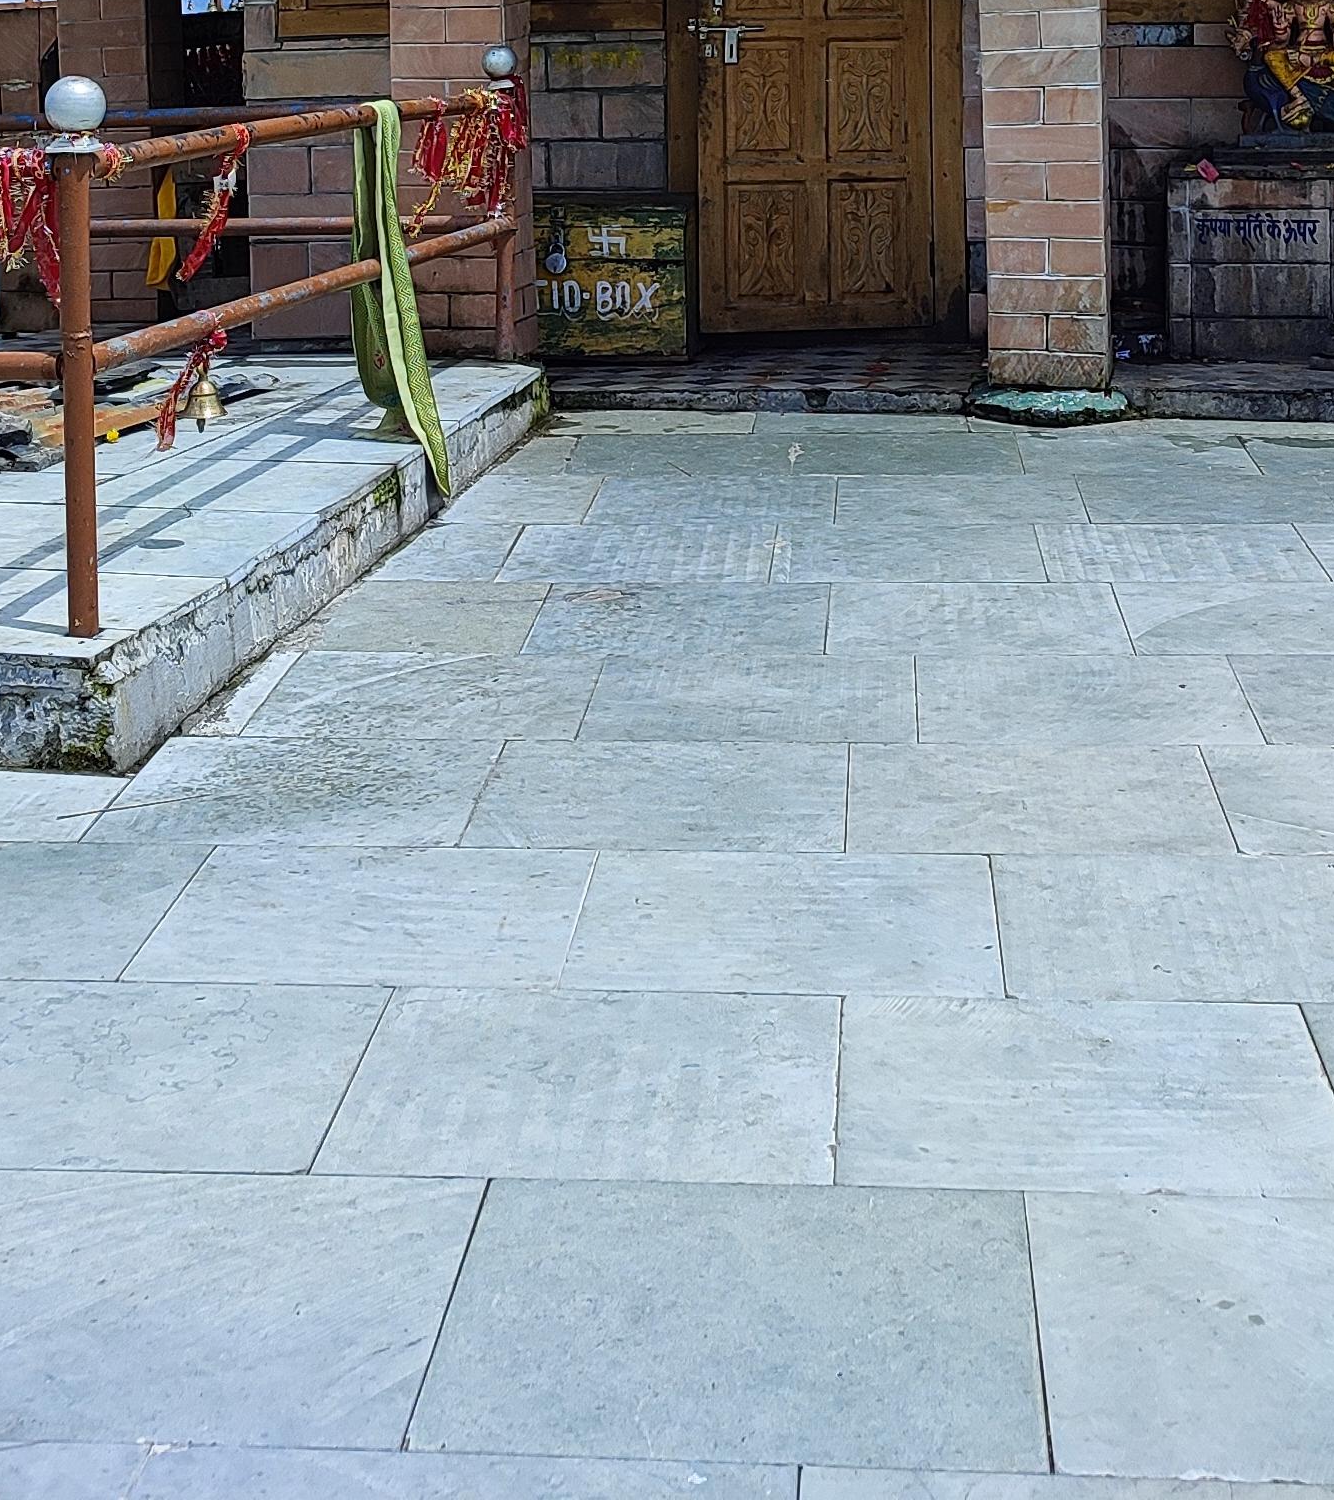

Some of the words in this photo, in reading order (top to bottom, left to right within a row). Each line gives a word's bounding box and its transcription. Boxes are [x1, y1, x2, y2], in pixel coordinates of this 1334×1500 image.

[1194, 218, 1234, 245] कृपया
[1233, 213, 1267, 252] मूर्ति
[1265, 213, 1282, 241] के
[1282, 218, 1321, 245] ऊपर
